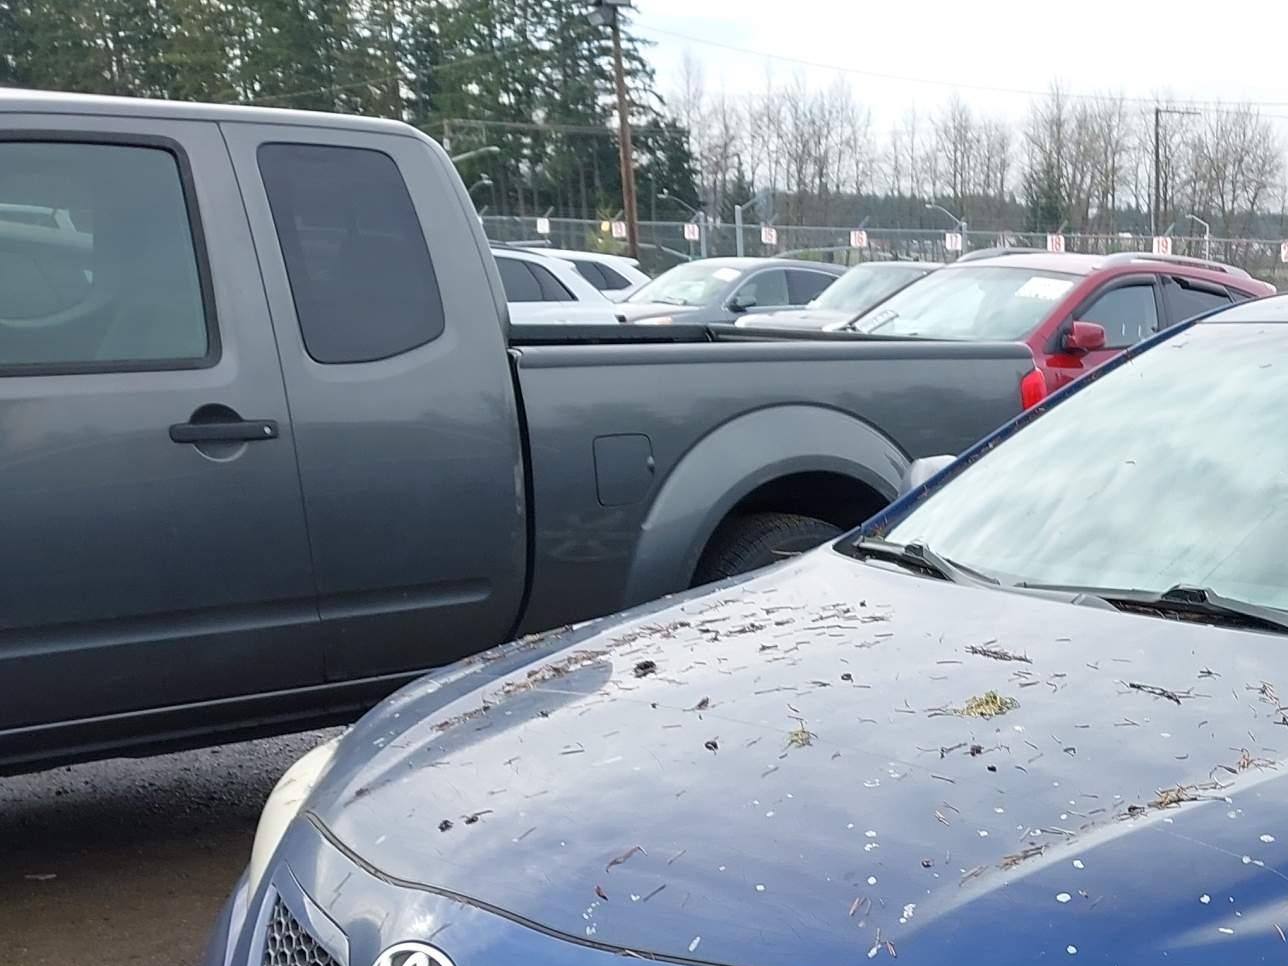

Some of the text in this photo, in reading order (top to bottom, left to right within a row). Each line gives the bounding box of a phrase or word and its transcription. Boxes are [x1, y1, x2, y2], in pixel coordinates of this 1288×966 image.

[764, 229, 774, 242] 15
[1051, 236, 1061, 250] 18
[1156, 239, 1169, 254] 19
